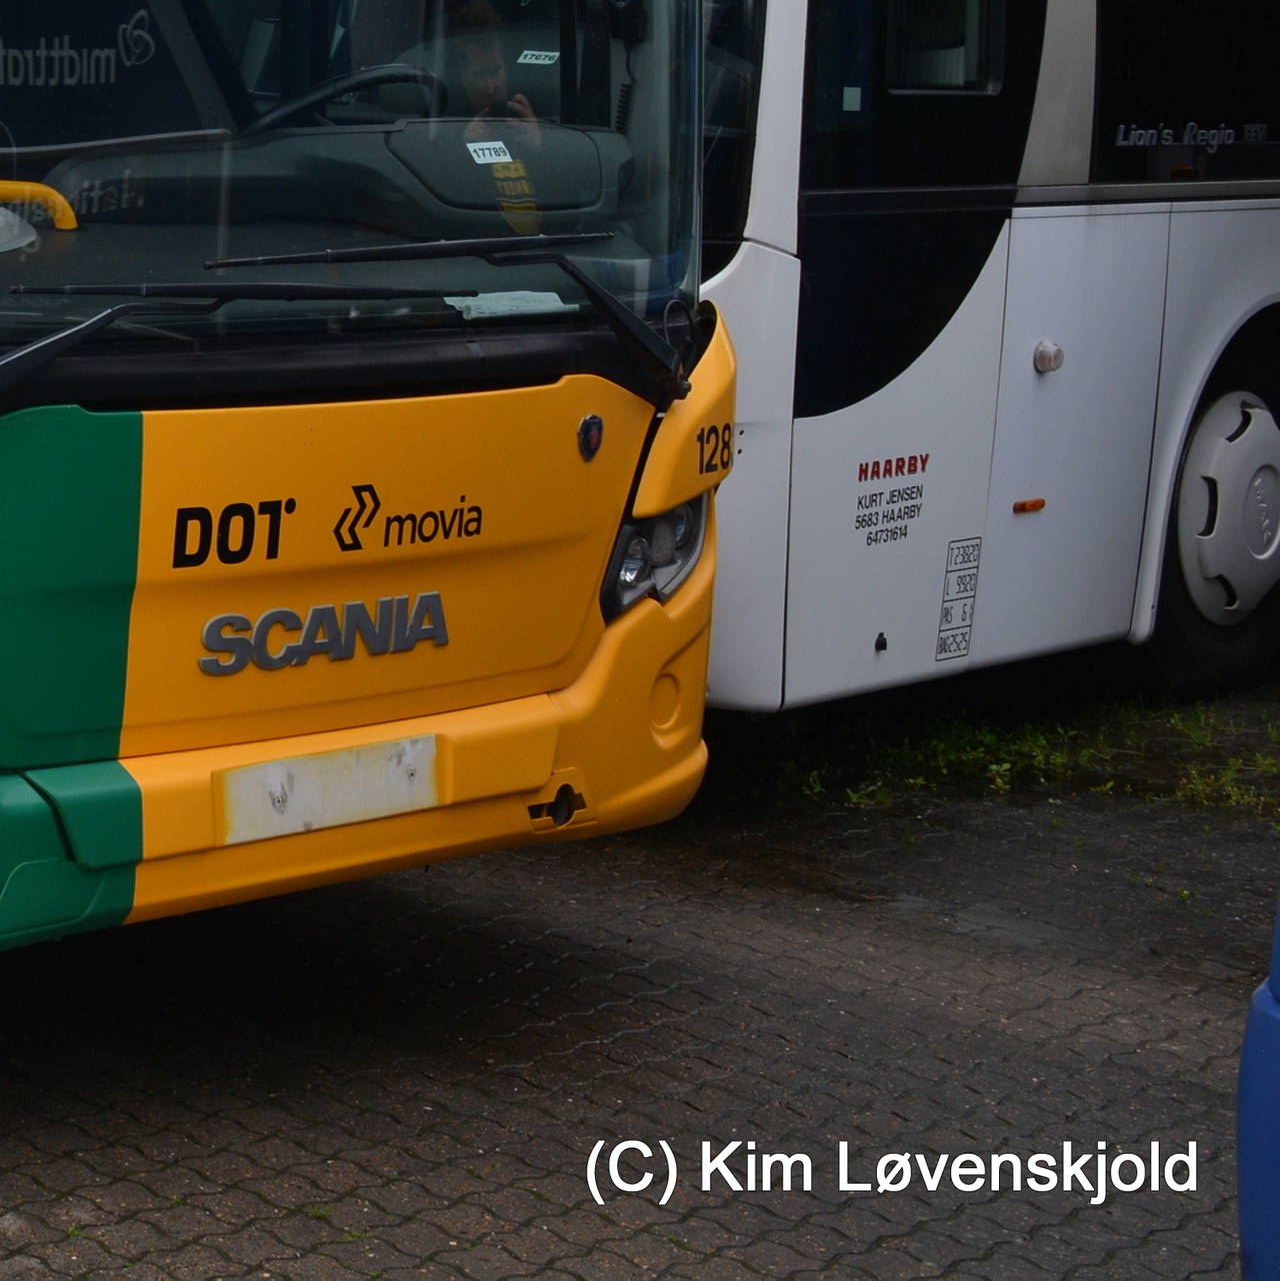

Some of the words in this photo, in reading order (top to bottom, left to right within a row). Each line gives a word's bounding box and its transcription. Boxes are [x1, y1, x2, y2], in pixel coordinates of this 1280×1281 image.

[523, 53, 556, 61] 17676
[473, 147, 507, 158] 17789
[1115, 123, 1174, 146] Lion's
[1182, 121, 1236, 154] Regio
[696, 422, 733, 475] 128
[858, 452, 929, 482] HAARBY
[857, 492, 884, 511] KURT
[885, 484, 923, 505] JENSEN
[383, 495, 483, 548] movia
[855, 511, 880, 530] 5683
[881, 503, 923, 525] HAARBY
[172, 498, 297, 569] DOT
[866, 523, 908, 547] 64731614
[198, 590, 449, 677] SCANIA
